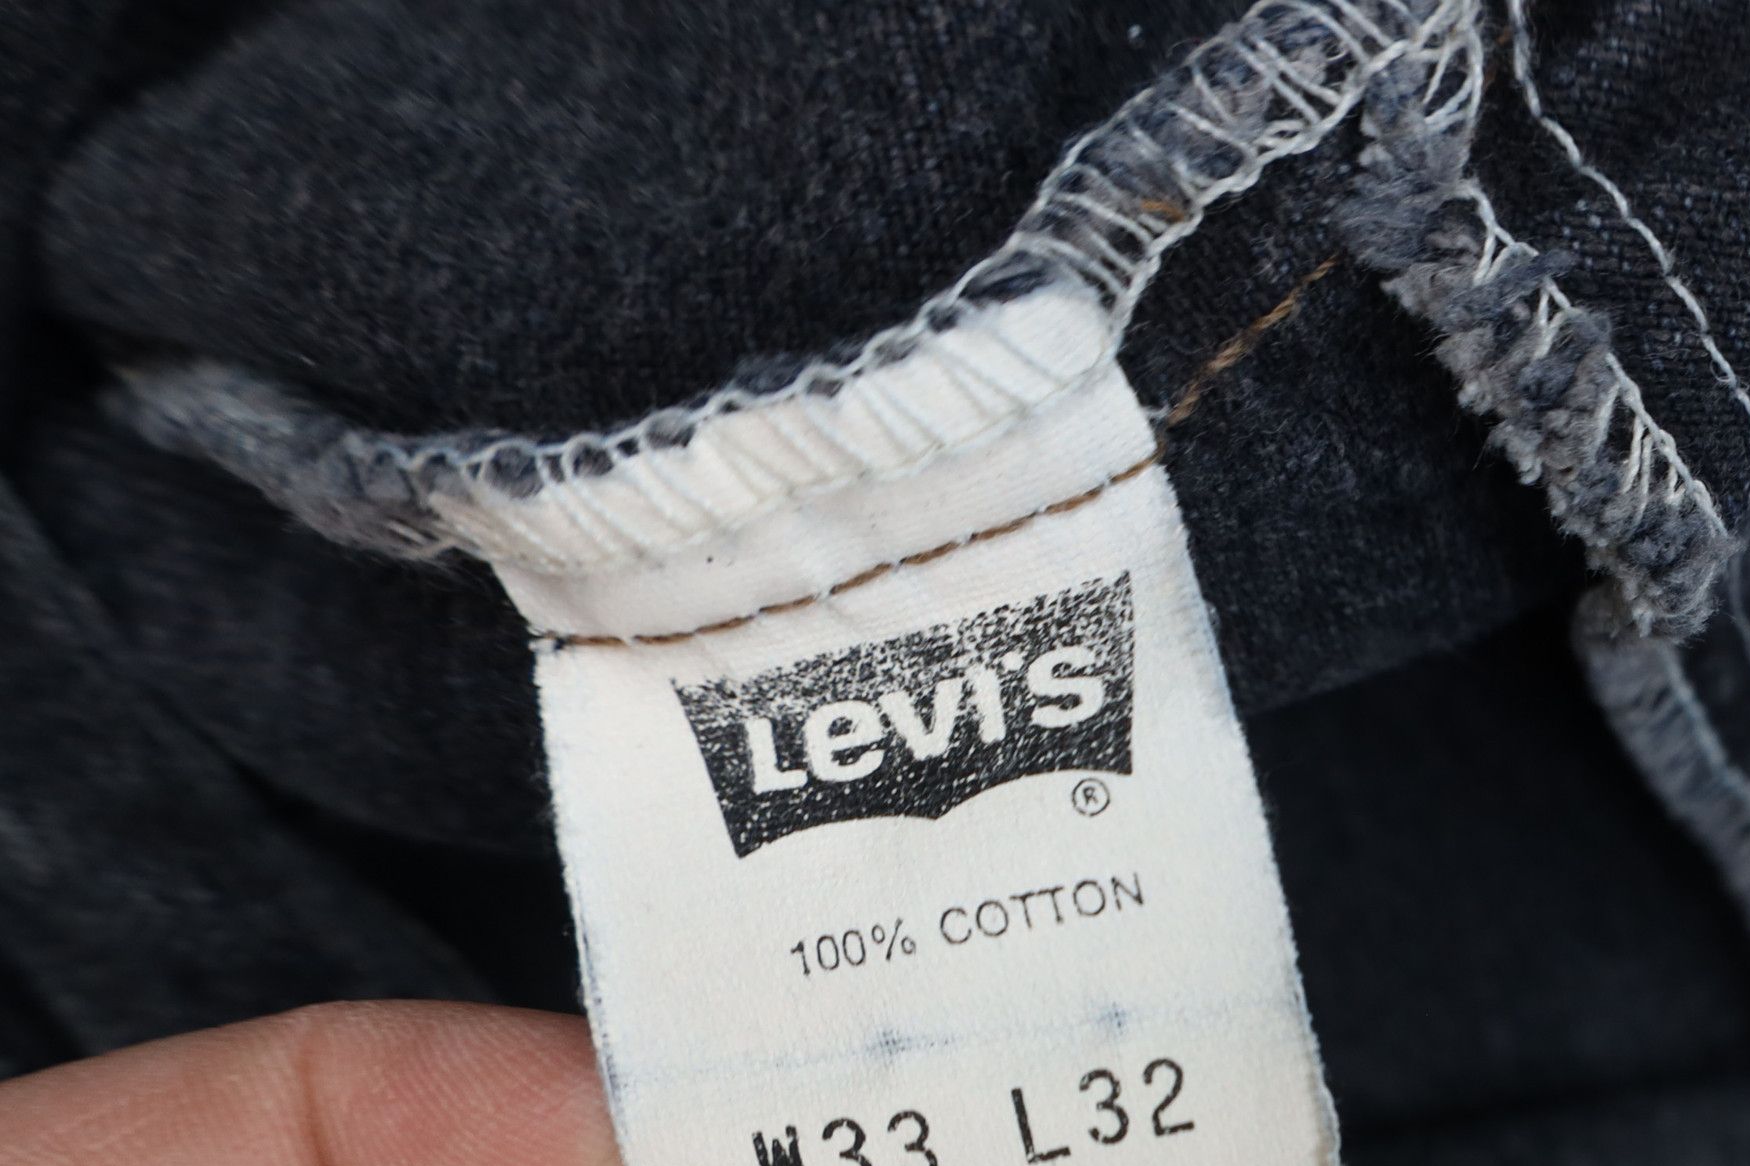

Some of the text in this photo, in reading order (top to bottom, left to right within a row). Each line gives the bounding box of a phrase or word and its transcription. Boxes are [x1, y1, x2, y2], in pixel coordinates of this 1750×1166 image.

[745, 645, 1106, 796] Levi's
[790, 872, 1145, 977] 100% COTTON
[1011, 1057, 1195, 1164] L32
